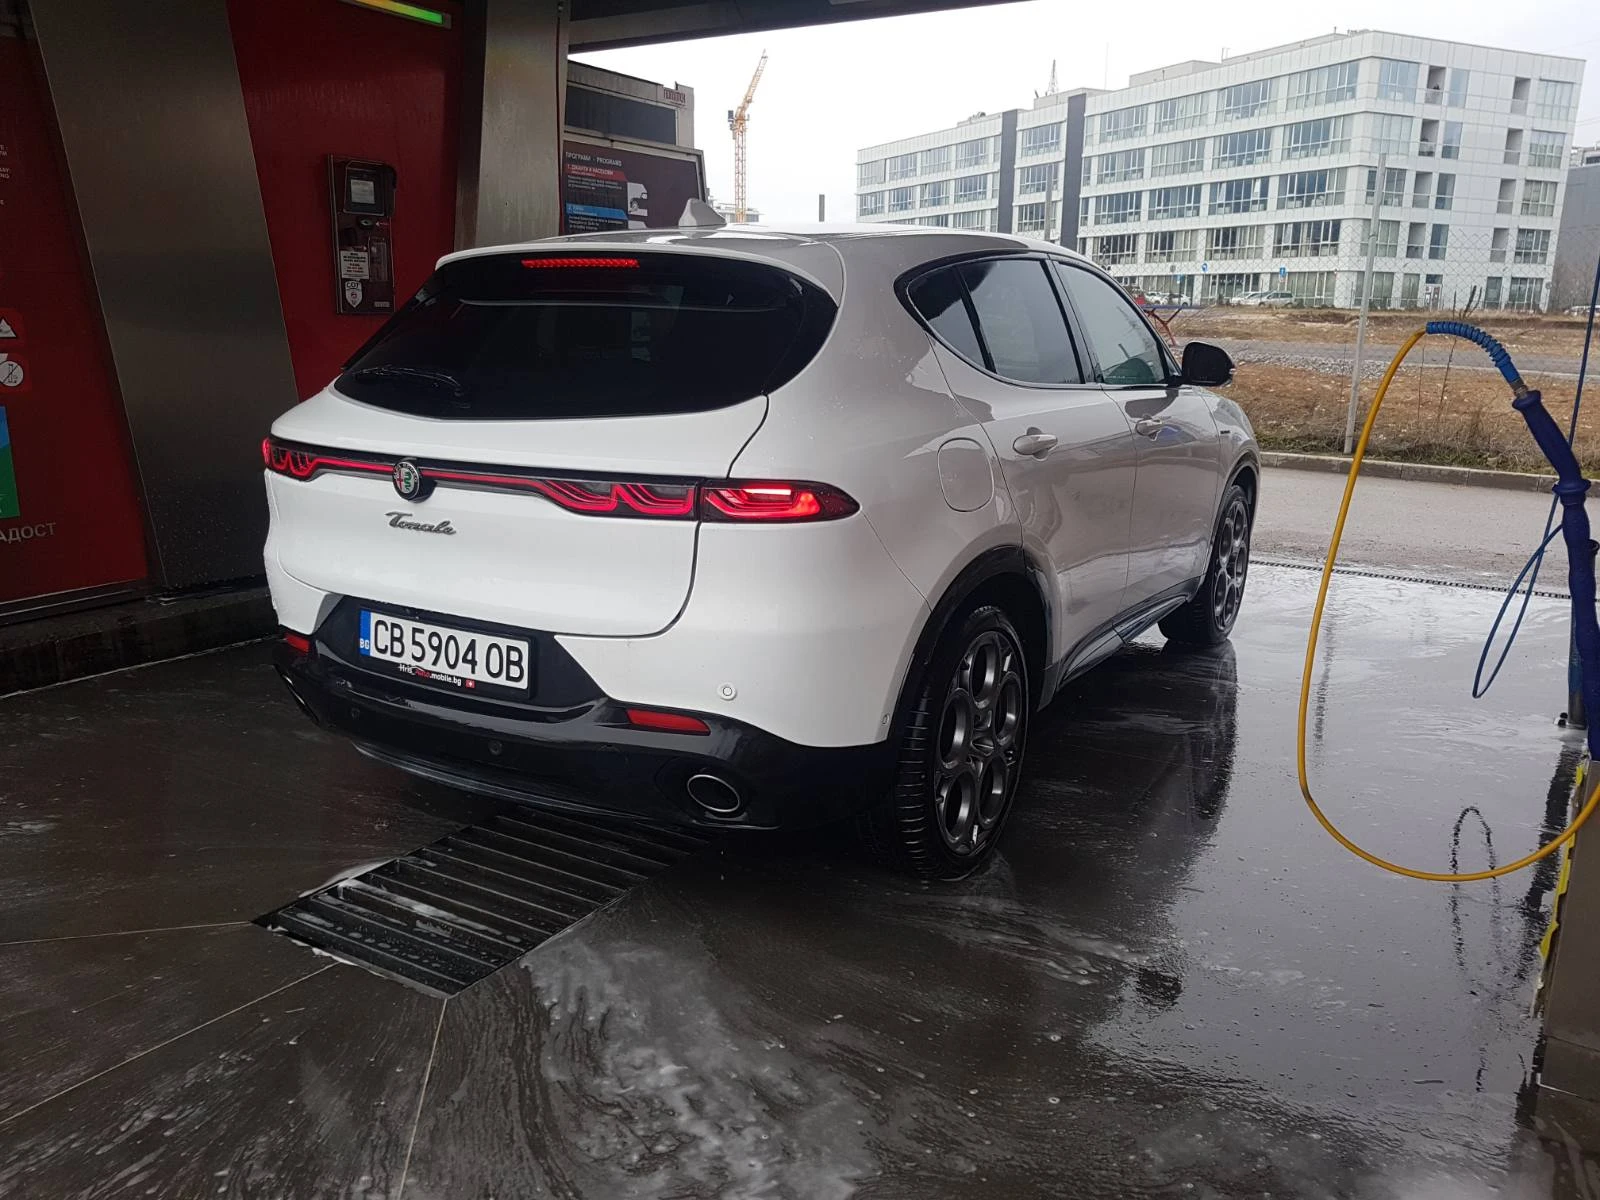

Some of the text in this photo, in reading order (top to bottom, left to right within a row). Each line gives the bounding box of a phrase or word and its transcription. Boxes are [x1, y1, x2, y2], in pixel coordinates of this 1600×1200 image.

[385, 511, 457, 535] Tonale
[359, 638, 370, 650] BG
[374, 619, 525, 683] CB 5904 OB
